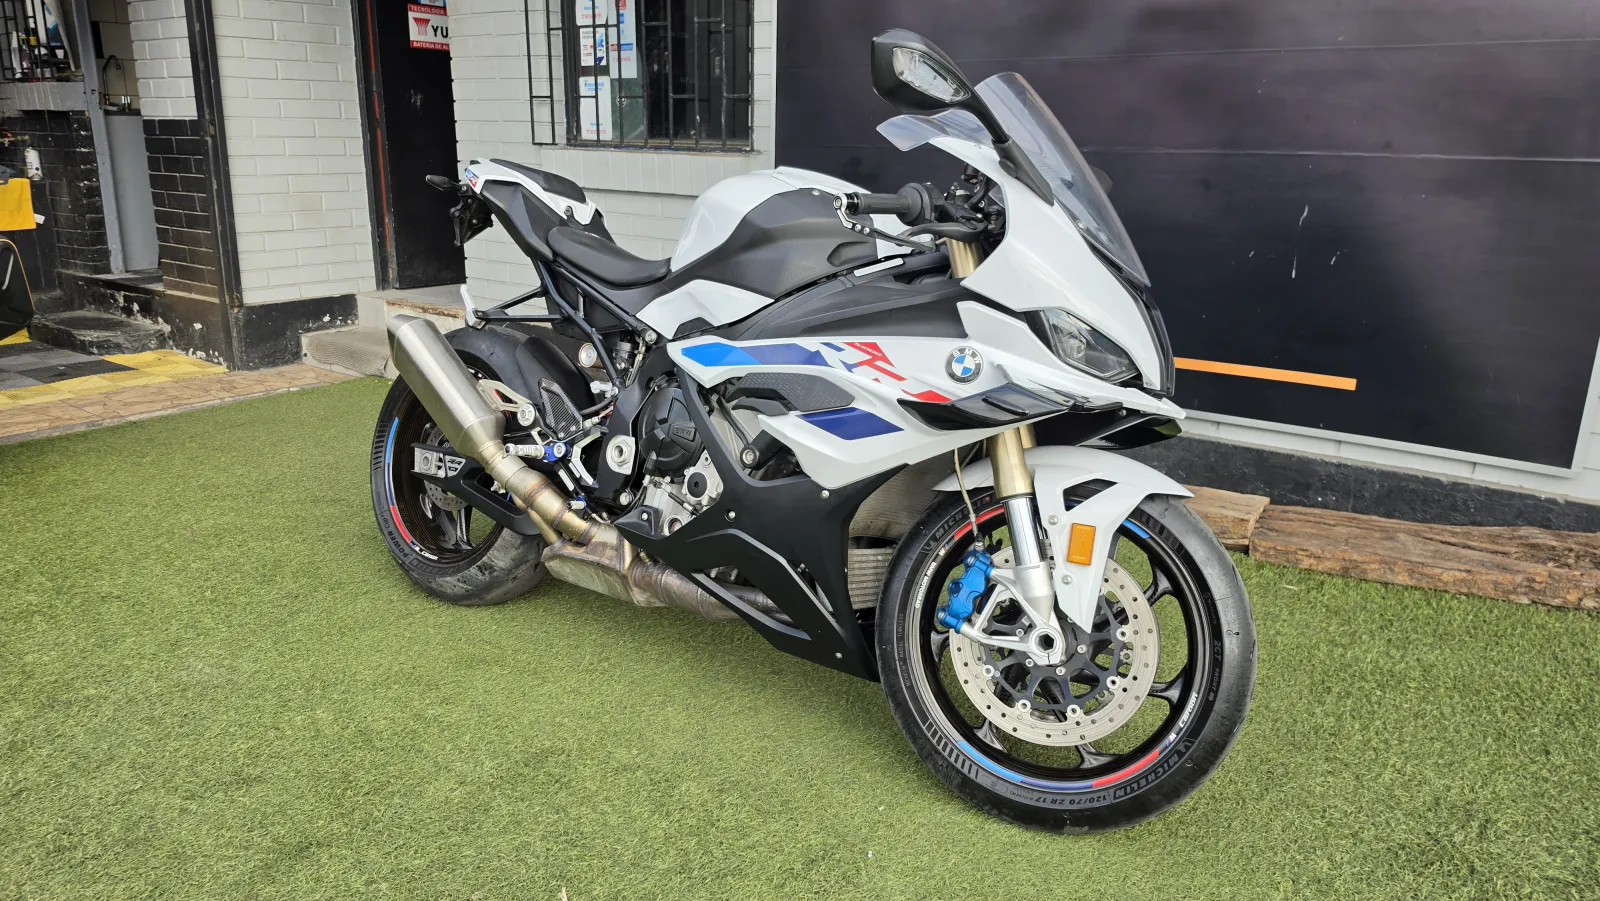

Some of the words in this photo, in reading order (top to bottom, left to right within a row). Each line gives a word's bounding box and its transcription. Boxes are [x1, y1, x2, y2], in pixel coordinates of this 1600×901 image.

[431, 25, 450, 39] YU
[387, 530, 409, 558] POWER
[1211, 667, 1220, 692] FRONT
[1115, 752, 1179, 798] MICHELIN
[1035, 796, 1047, 804] 17
[1069, 795, 1108, 805] 120/70
